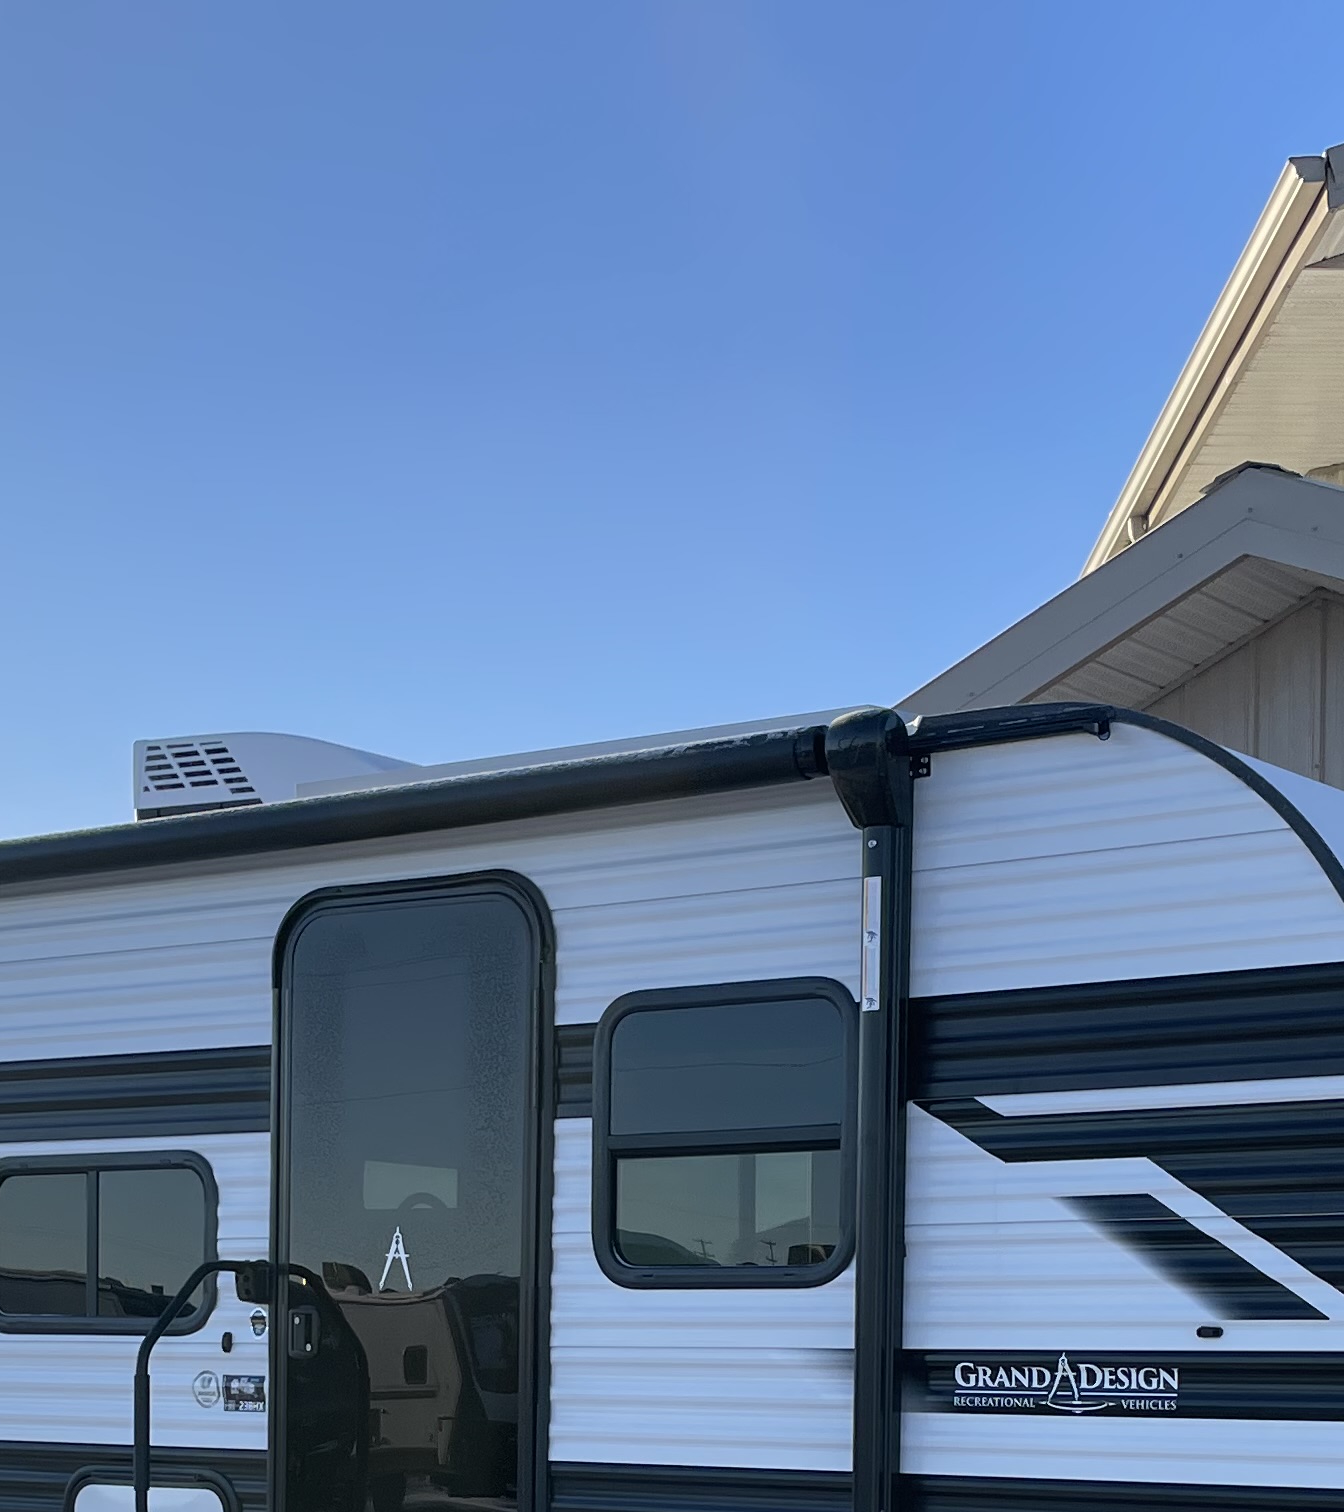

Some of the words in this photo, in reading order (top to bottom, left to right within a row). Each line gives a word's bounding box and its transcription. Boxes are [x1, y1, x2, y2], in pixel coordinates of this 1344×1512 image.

[954, 1362, 1051, 1388] GRAND
[1077, 1363, 1179, 1391] DESIGN
[953, 1396, 1036, 1408] RECREATIONAL
[1121, 1399, 1177, 1411] VEHICLES
